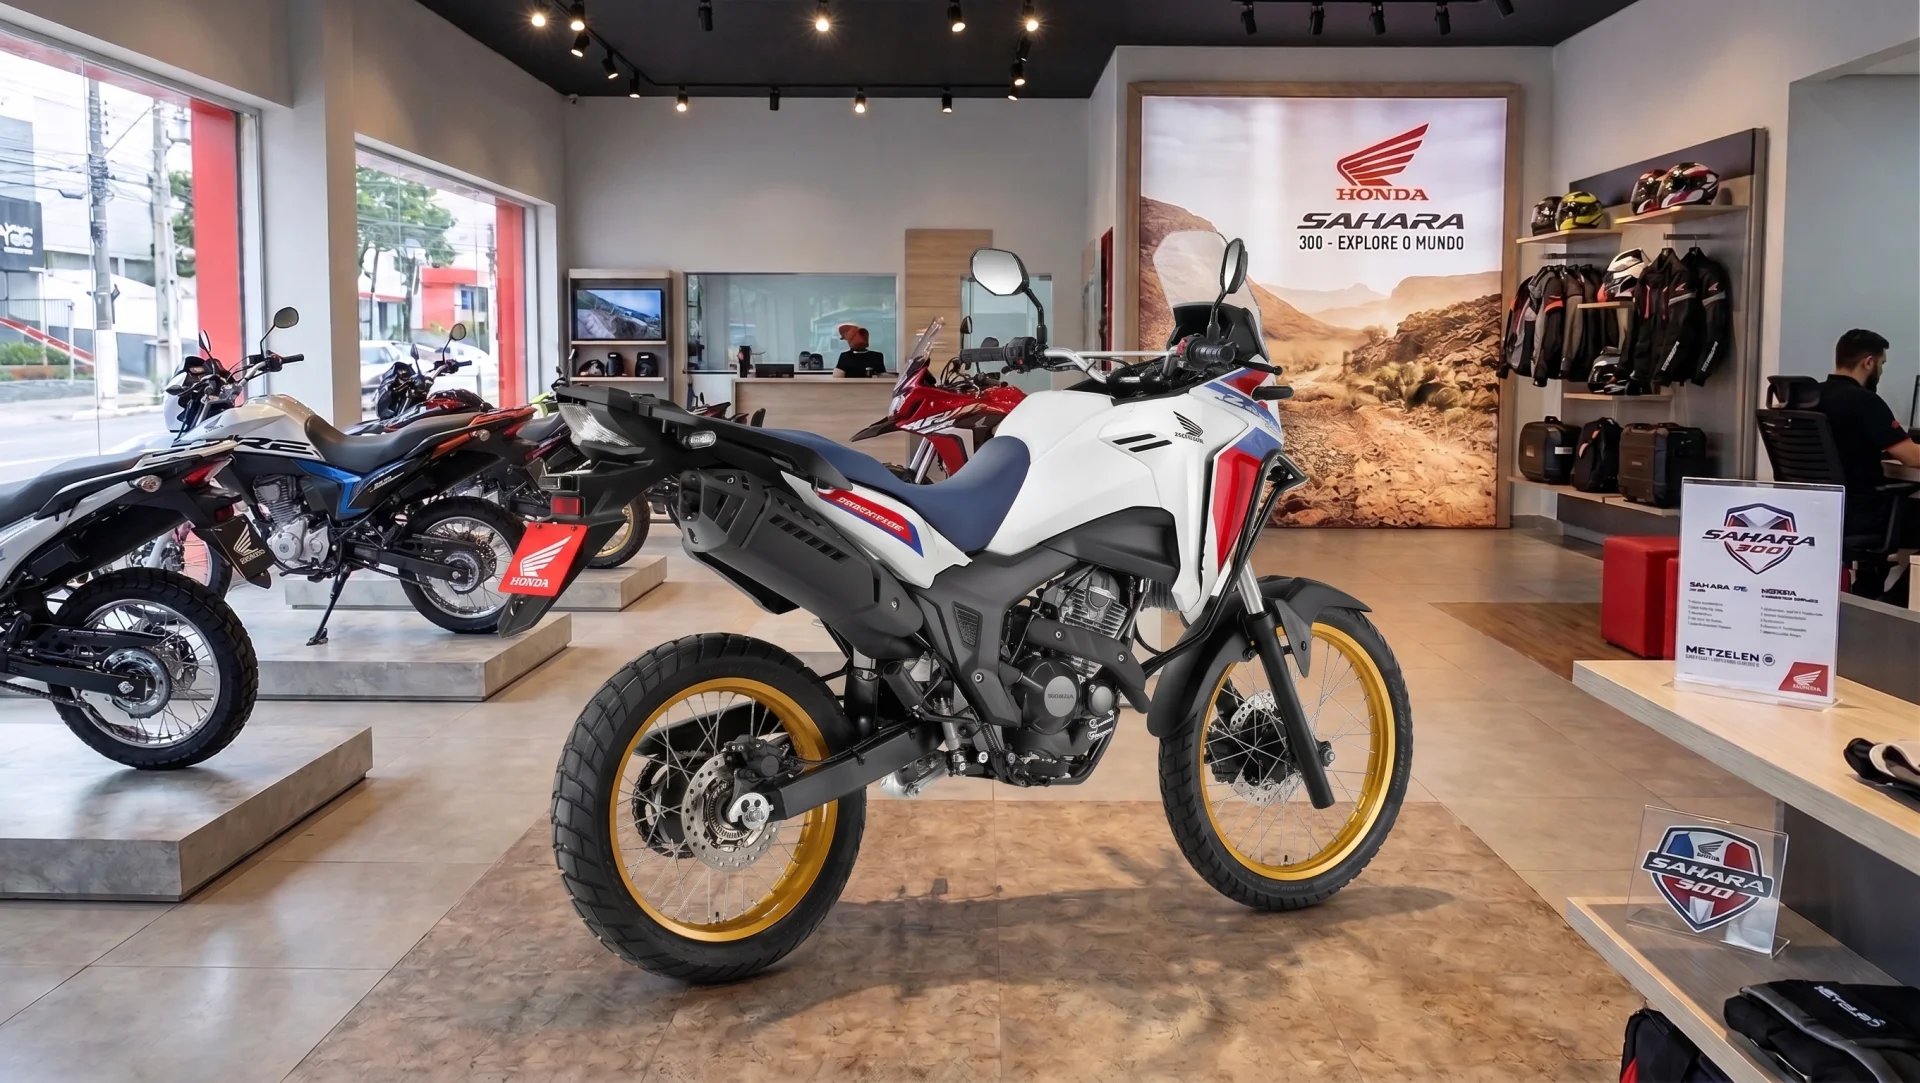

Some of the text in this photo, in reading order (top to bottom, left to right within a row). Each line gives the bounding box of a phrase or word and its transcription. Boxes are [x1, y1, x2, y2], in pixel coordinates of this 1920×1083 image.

[1336, 188, 1430, 201] HONDA
[1297, 213, 1465, 230] SAHARA
[1299, 235, 1323, 250] 300
[1338, 235, 1398, 250] EXPLORE
[1402, 235, 1411, 250] O
[1416, 236, 1464, 250] MUNDO
[1702, 529, 1815, 547] SAHARA
[1735, 543, 1784, 555] 300
[509, 576, 549, 588] HONDA
[1685, 645, 1760, 663] METZELEN
[1648, 857, 1765, 893] SAHARA
